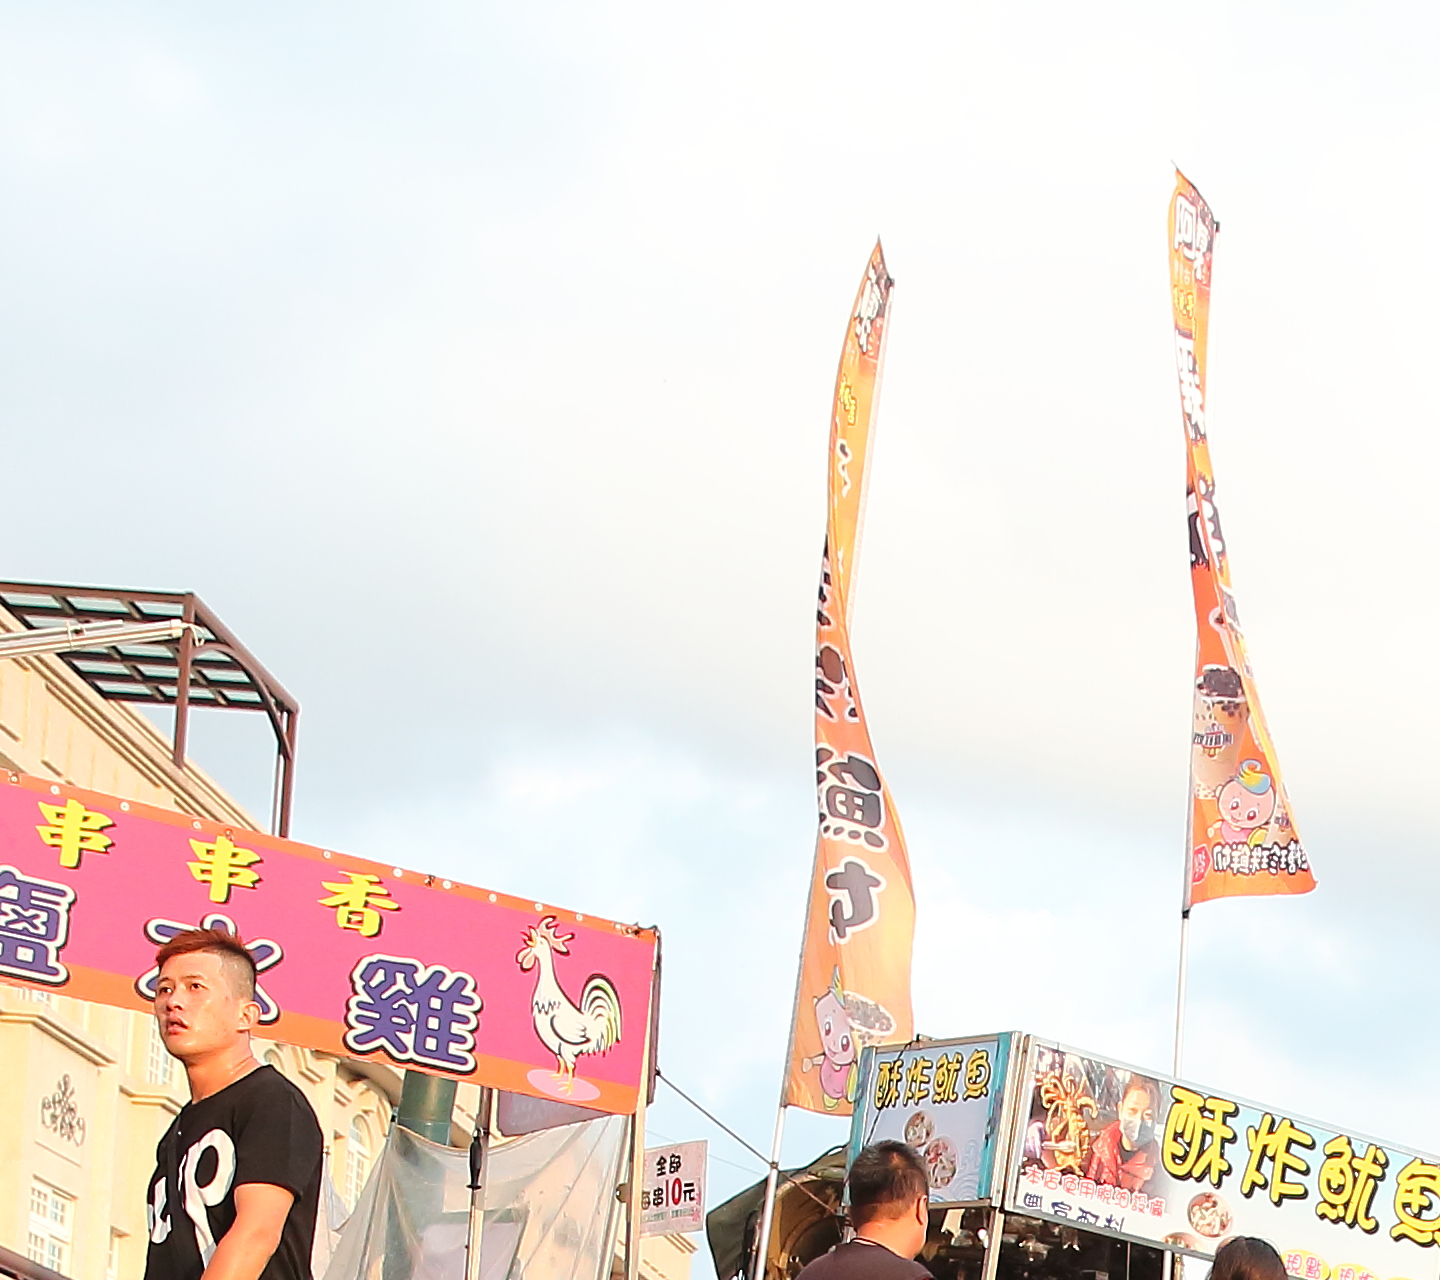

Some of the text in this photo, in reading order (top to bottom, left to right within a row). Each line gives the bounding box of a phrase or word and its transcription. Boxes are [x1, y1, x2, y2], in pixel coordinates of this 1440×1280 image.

[35, 797, 403, 939] 串串香
[874, 1048, 992, 1109] 酥炸魷魚
[656, 1152, 682, 1177] 全部
